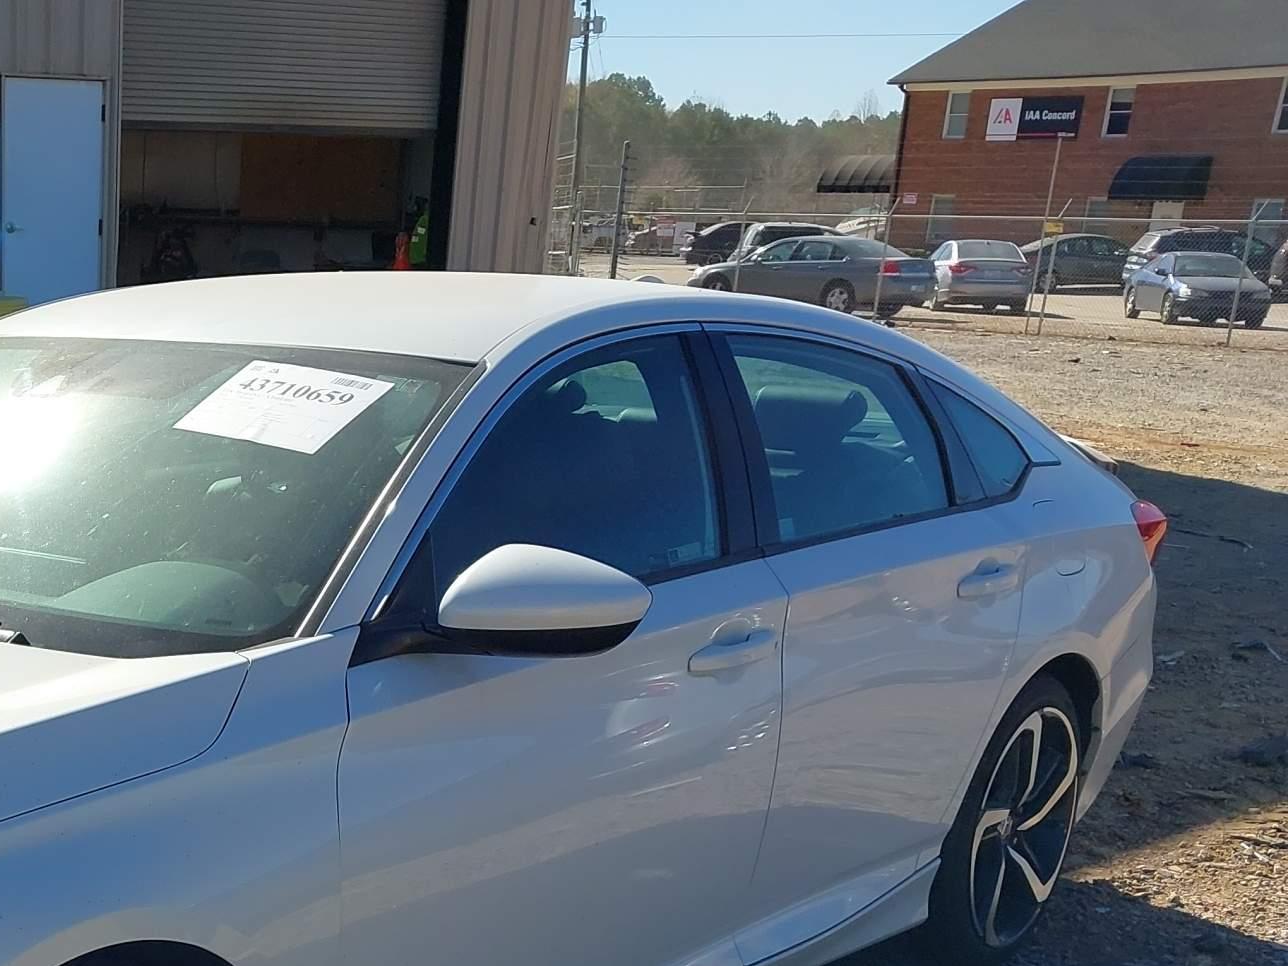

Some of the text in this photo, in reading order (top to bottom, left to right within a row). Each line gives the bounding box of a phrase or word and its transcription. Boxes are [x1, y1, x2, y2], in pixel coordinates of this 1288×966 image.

[1024, 109, 1077, 120] IAA Concord
[239, 377, 355, 406] 43710659
